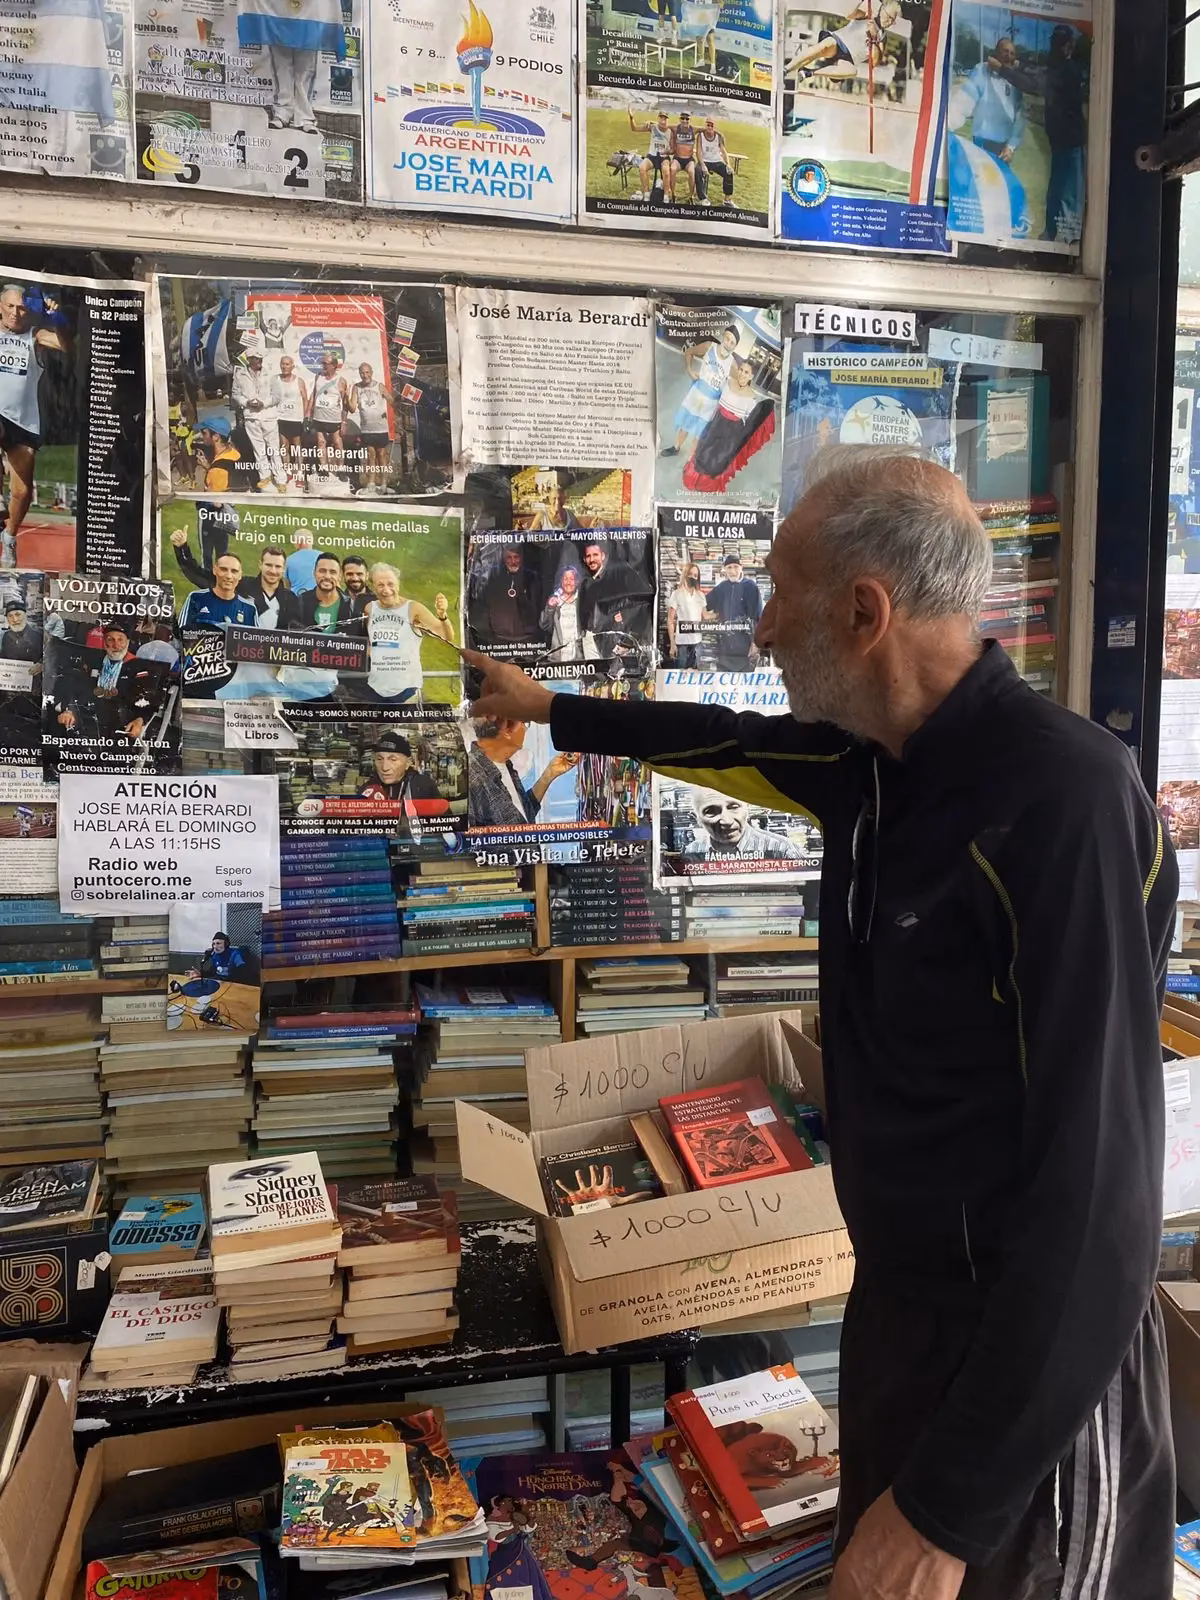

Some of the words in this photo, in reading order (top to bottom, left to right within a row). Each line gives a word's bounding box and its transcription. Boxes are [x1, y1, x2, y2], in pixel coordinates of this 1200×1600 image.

[496, 56, 504, 65] 9
[509, 57, 563, 75] PODIOS
[598, 74, 635, 86] Recuerdo
[637, 76, 647, 86] de
[649, 78, 661, 88] Las
[664, 81, 707, 94] Olimpiadas
[709, 84, 743, 97] Europeas
[745, 91, 761, 100] 2011
[9, 101, 57, 114] Australia
[20, 119, 47, 130] 2005
[400, 123, 469, 137] SUDAMERICANO
[20, 135, 47, 145] 2006
[414, 134, 531, 157] ARGENTINA
[31, 150, 75, 163] Torneos
[284, 148, 308, 188] 2
[393, 152, 462, 173] JOSE
[469, 158, 553, 183] MARIA
[416, 173, 533, 200] BERARDI
[607, 202, 639, 212] Compañía
[650, 206, 679, 216] Campeón
[681, 208, 695, 216] Ruso
[708, 210, 736, 220] Campeón
[738, 212, 759, 222] Alemán
[85, 296, 107, 307] Unico
[110, 297, 142, 308] Campeón
[90, 309, 99, 320] En
[102, 311, 112, 320] 32
[469, 304, 510, 319] José
[517, 306, 572, 323] María
[579, 309, 648, 327] Berardi
[662, 308, 686, 317] Nuevo
[660, 318, 729, 327] Centroamericano
[800, 308, 912, 338] TÉCNICOS
[92, 335, 120, 343] Edmonton
[668, 329, 697, 337] Master
[91, 350, 120, 358] Vancouver
[808, 356, 867, 367] HISTÓRICO
[870, 356, 923, 368] CAMPEÓN
[835, 374, 857, 382] JOSE
[860, 374, 889, 383] MARÍA
[872, 414, 910, 426] EUROPEAN
[872, 424, 909, 436] MASTERS
[198, 508, 239, 523] Grupo
[243, 511, 308, 530] Argentino
[312, 517, 335, 531] que
[340, 519, 368, 530] mas
[372, 519, 430, 534] medallas
[674, 509, 695, 521] CON
[699, 511, 720, 523] UNA
[722, 512, 757, 524] AMIGA
[685, 525, 698, 537] DE
[702, 526, 714, 537] LA
[718, 527, 745, 538] CASA
[235, 530, 265, 544] trajo
[269, 533, 286, 544] en
[290, 534, 314, 544] una
[318, 534, 396, 550] competición
[58, 579, 163, 596] VOLVEMOS
[43, 598, 172, 617] VICTORIOSOS
[233, 631, 240, 640] El
[242, 632, 280, 644] Campeón
[282, 636, 314, 647] Mundial
[327, 639, 365, 651] Argentino
[373, 631, 399, 641] 80025
[232, 642, 264, 659] José
[269, 644, 307, 663] María
[312, 650, 362, 668] Berardi
[665, 671, 715, 685] FELIZ
[42, 735, 113, 749] Esperando
[118, 737, 129, 747] el
[135, 739, 170, 748] Avion
[245, 730, 279, 740] Libros
[59, 751, 96, 761] Nuevo
[100, 751, 153, 763] Campeón
[57, 763, 157, 775] Centroamericano
[115, 779, 217, 799] ATENCIÓN
[78, 803, 121, 815] JOSE
[126, 802, 177, 816] MARÍA
[182, 804, 252, 817] BERARDI
[74, 818, 150, 832] HABLARÁ
[155, 821, 174, 832] EL
[179, 821, 256, 833] DOMINGO
[109, 837, 121, 849] A
[125, 837, 155, 849] LAS
[161, 837, 221, 850] 11:15HS
[483, 834, 523, 845] LIBRERÍA
[539, 833, 555, 842] LOS
[511, 848, 563, 864] Visita
[568, 846, 588, 860] de
[88, 857, 138, 871] Radio
[144, 857, 178, 871] web
[215, 866, 252, 876] Espero
[722, 861, 780, 870] MARATONISTA
[782, 859, 819, 867] ETERNO
[74, 875, 192, 888] puntocero.me
[87, 889, 195, 900] sobrelalinea.ar
[201, 888, 265, 898] comentarios
[60, 963, 79, 971] Alas
[580, 1064, 650, 1099] 1000
[671, 1096, 720, 1110] MANTENIENDO
[674, 1098, 741, 1116] ESTRATÉGICAMENTE
[691, 1108, 730, 1120] DISTANCIAS
[560, 1148, 601, 1159] Christiaan
[603, 1141, 636, 1151] Barnard
[6, 1180, 59, 1195] JOHN
[257, 1174, 316, 1191] Sidney
[245, 1186, 321, 1207] Sheldon
[256, 1204, 274, 1214] LOS
[276, 1197, 324, 1211] MEJORES
[279, 1203, 326, 1219] PLANES
[621, 1208, 711, 1241] 1000
[599, 1293, 664, 1312] GRANOLA
[668, 1286, 690, 1298] CON
[695, 1276, 741, 1293] AVENA,
[745, 1257, 824, 1281] ALMENDRAS
[633, 1302, 672, 1317] AVEIA,
[754, 1269, 822, 1291] AMENDOINS
[110, 1310, 132, 1318] EL
[138, 1301, 216, 1316] CASTIGO
[642, 1313, 676, 1326] OATS,
[679, 1299, 735, 1319] ALMONDS
[739, 1295, 759, 1304] AND
[763, 1281, 816, 1299] PEANUTS
[126, 1318, 150, 1328] DE
[157, 1312, 202, 1325] DIOS
[708, 1405, 740, 1416] Puss
[744, 1400, 759, 1408] in
[762, 1388, 801, 1403] Boots
